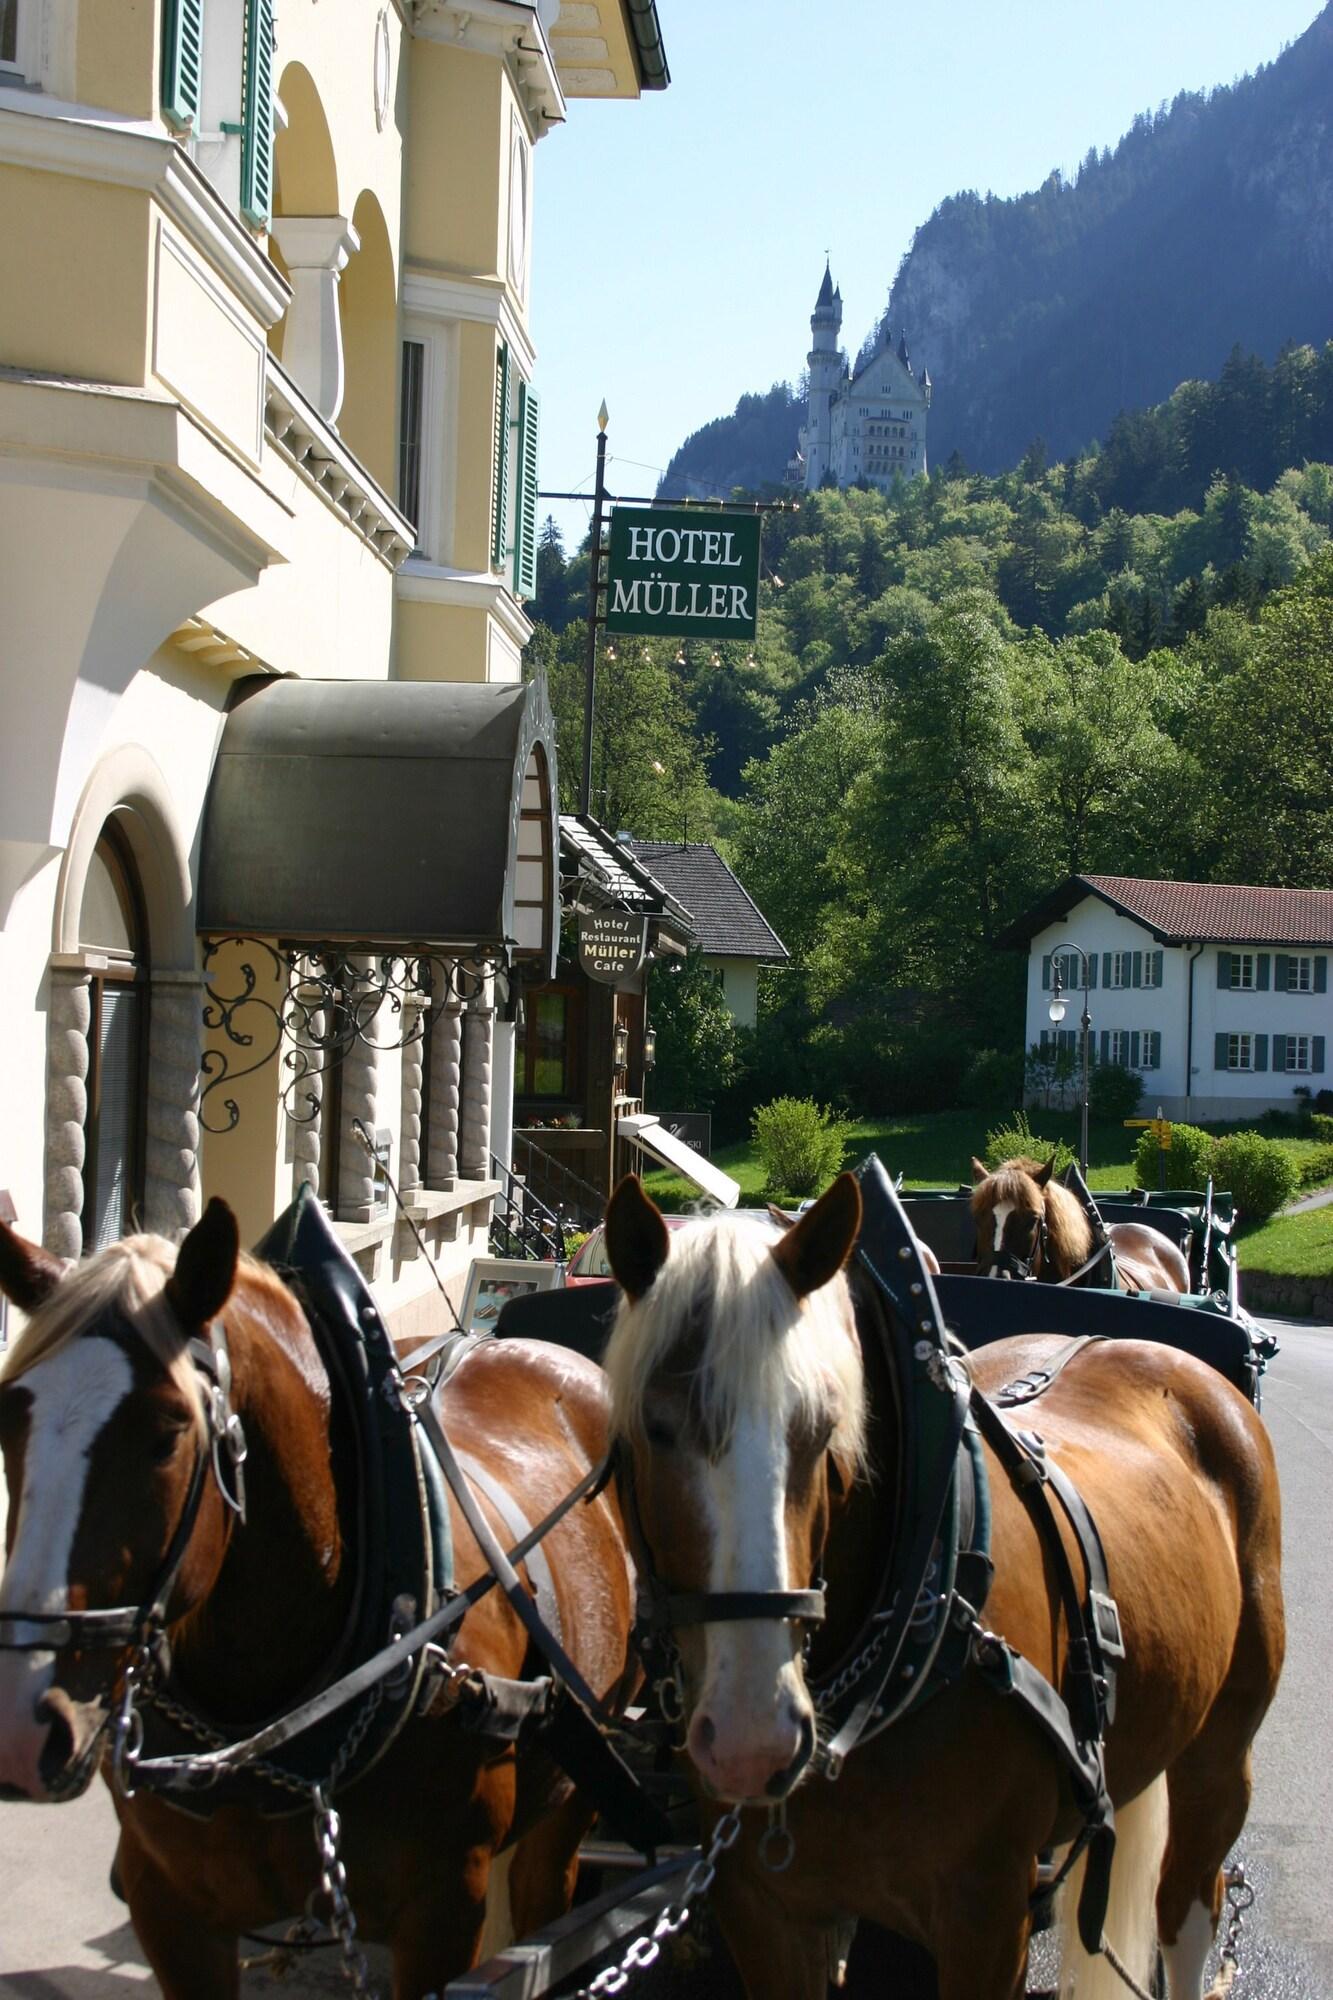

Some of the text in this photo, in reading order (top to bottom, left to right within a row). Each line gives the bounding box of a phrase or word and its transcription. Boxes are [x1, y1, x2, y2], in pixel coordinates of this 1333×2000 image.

[627, 527, 742, 566] HOTEL
[610, 572, 753, 620] MÜLLER
[594, 919, 629, 931] Hotel
[581, 931, 641, 944] Restaurant
[584, 944, 636, 958] Müller
[594, 960, 624, 971] Cafe
